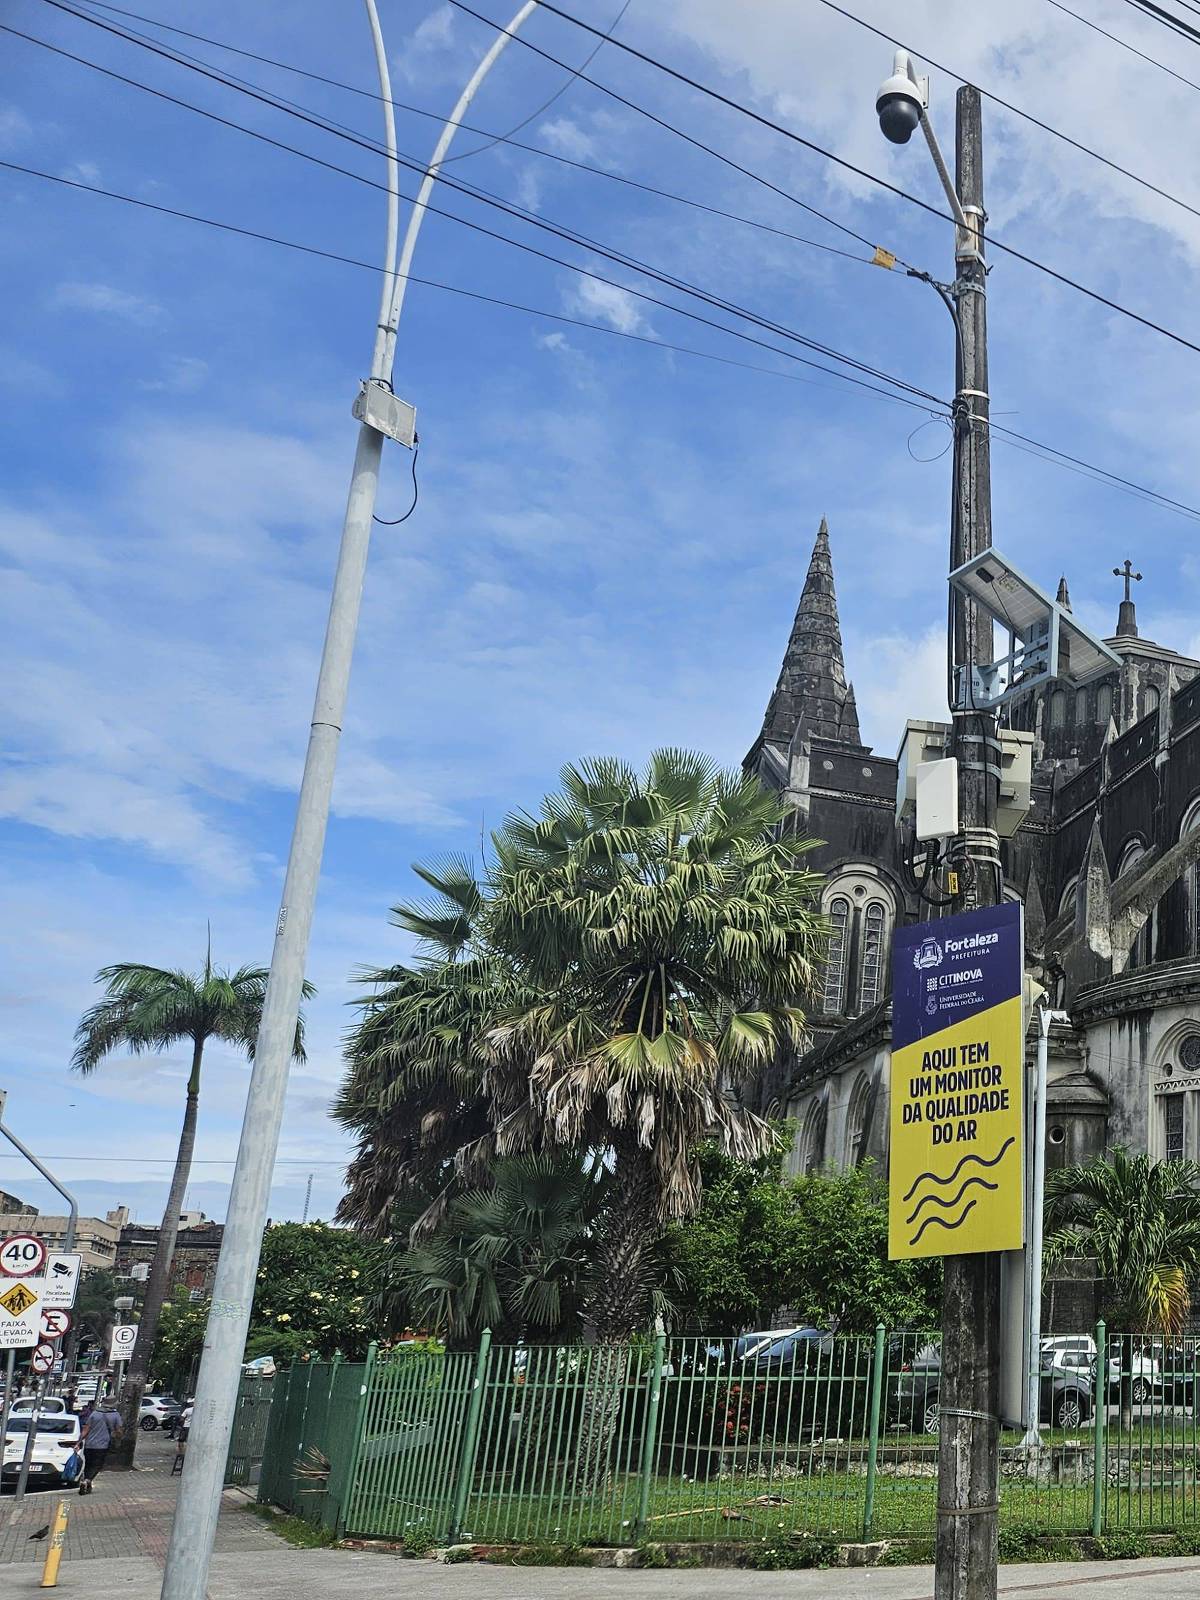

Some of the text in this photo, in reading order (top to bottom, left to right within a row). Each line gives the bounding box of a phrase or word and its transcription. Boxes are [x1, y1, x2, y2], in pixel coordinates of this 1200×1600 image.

[944, 933, 999, 954] Fortaleza
[951, 948, 990, 961] PREFEITURA
[938, 968, 983, 986] CITINOVA
[939, 991, 977, 1003] UNIVERSIDADE
[939, 1001, 960, 1010] FEDERAL
[921, 1041, 989, 1072] AQUI TEM
[910, 1065, 1002, 1098] UM MONITOR
[903, 1089, 1009, 1125] DA QUALIDADE
[932, 1119, 977, 1145] DO AR
[5, 1243, 38, 1261] 40
[121, 1330, 128, 1340] E
